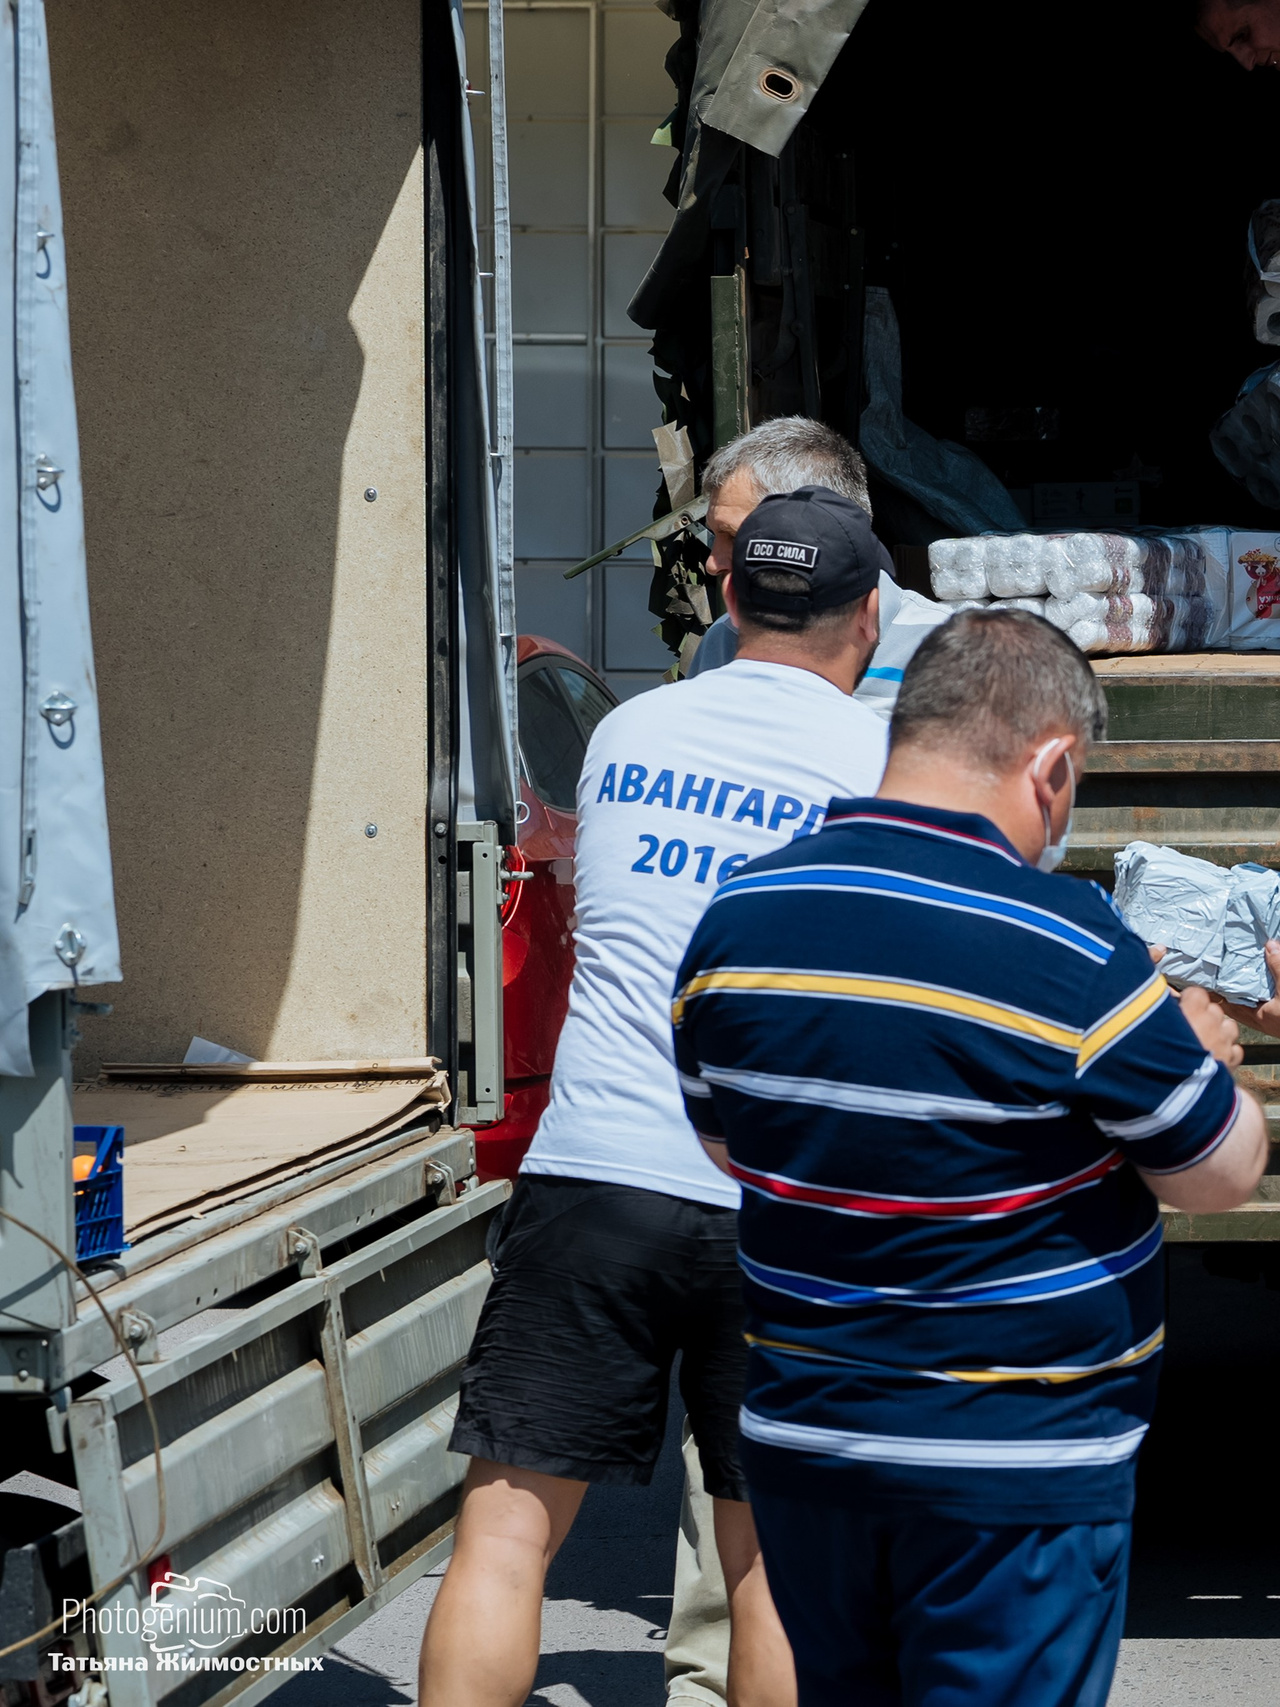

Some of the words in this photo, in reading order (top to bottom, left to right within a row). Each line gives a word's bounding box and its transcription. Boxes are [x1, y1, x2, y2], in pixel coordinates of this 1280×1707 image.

[753, 543, 774, 556] ОСО
[776, 545, 806, 562] СИЛА
[630, 833, 750, 885] 2016
